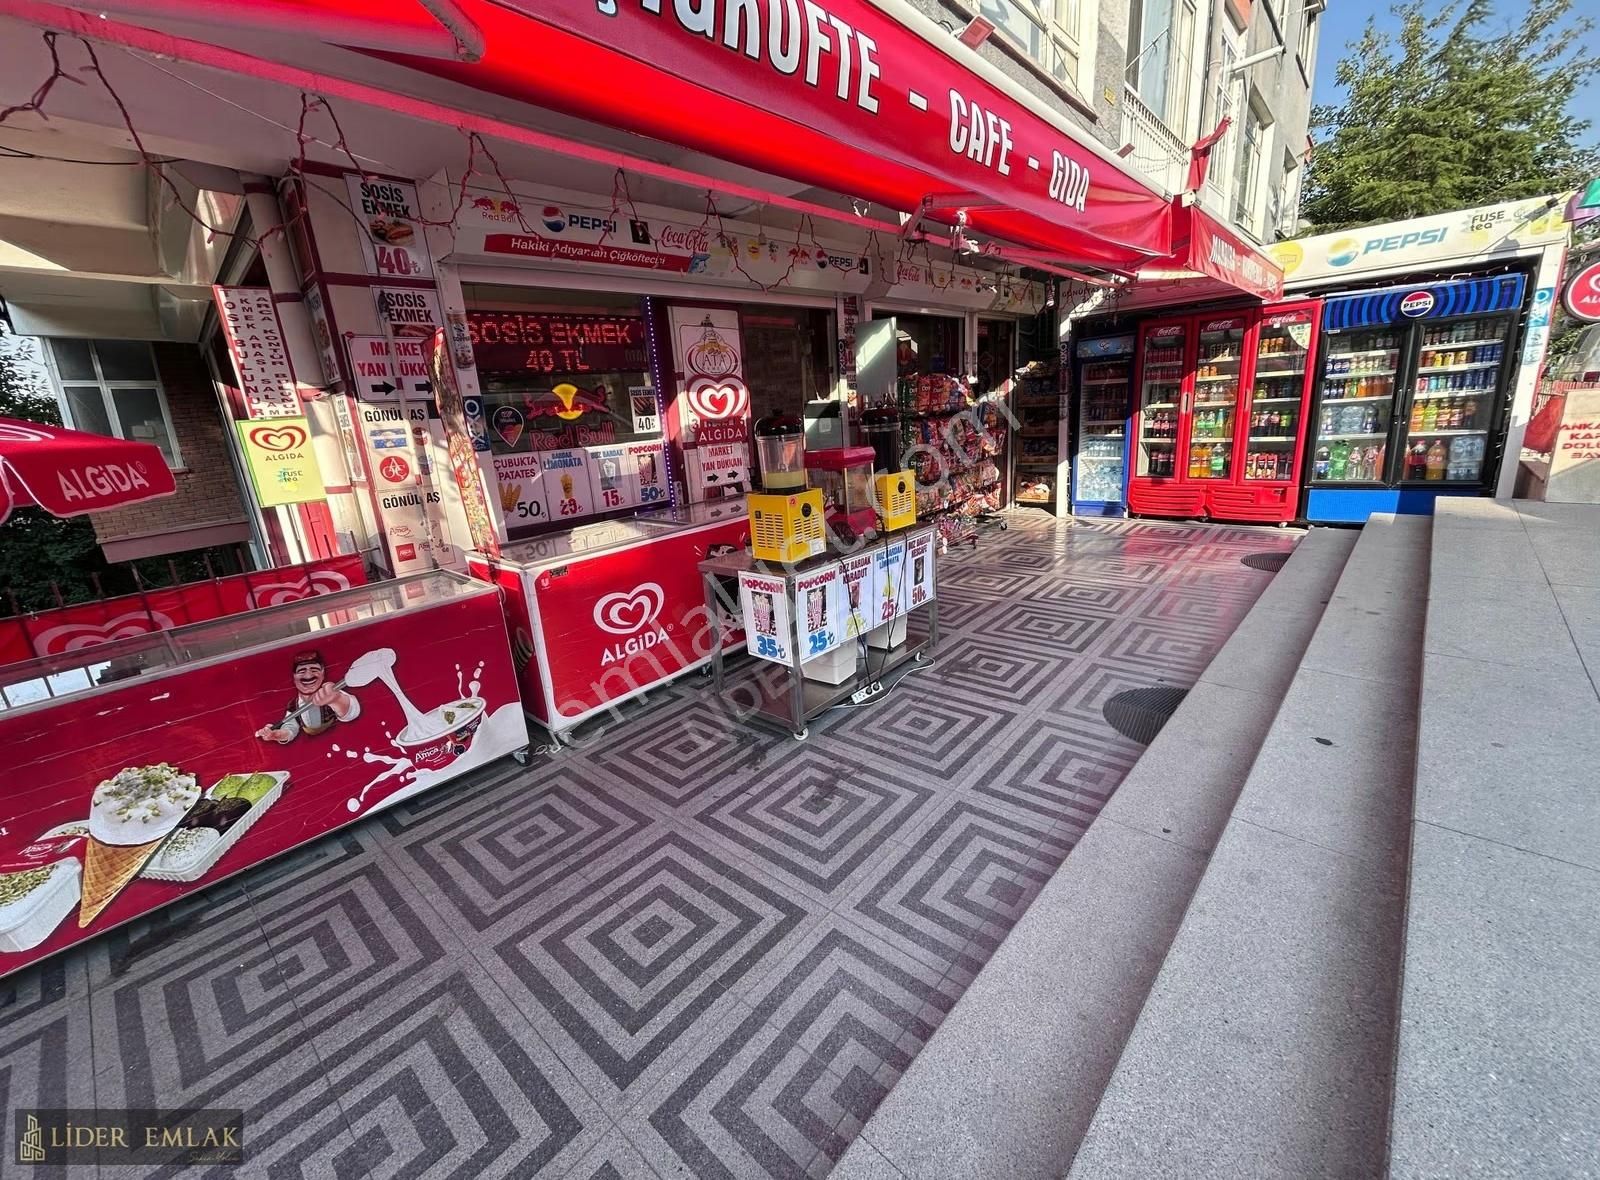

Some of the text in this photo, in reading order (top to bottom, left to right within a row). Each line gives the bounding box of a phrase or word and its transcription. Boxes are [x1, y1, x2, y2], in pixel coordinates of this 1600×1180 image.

[948, 88, 1014, 177] CAFE
[1048, 149, 1091, 212] GIDA
[568, 214, 617, 233] PEPSI
[1471, 210, 1505, 223] FUSE
[1471, 222, 1493, 231] tea
[510, 237, 550, 252] Hakiki
[1362, 226, 1447, 255] PEPSI
[386, 291, 426, 308] SOSİS
[1403, 299, 1432, 309] PEPSI
[389, 307, 434, 323] EKMEK
[467, 315, 545, 345] SOSİS
[551, 321, 632, 345] EKMEK
[357, 362, 387, 377] YAN
[390, 359, 428, 377] ÜKK
[526, 349, 590, 372] 40 TL
[364, 407, 425, 422] GÖNÜLAŞ
[1560, 423, 1600, 431] ANKA
[528, 421, 617, 451] Red Bull
[628, 443, 663, 456] POPCORN
[707, 446, 733, 457] MARKET
[1562, 442, 1600, 450] DOL
[265, 452, 304, 462] ALGIDA
[493, 455, 538, 472] ÇUBUKTA
[543, 456, 583, 471] LİMONATA
[701, 461, 717, 472] YAN
[499, 468, 537, 481] PATATES
[383, 491, 440, 509] GÖNÜLAŞ
[850, 555, 872, 570] BARDAK
[741, 577, 785, 594] POPCORN
[798, 570, 836, 592] POPCORN
